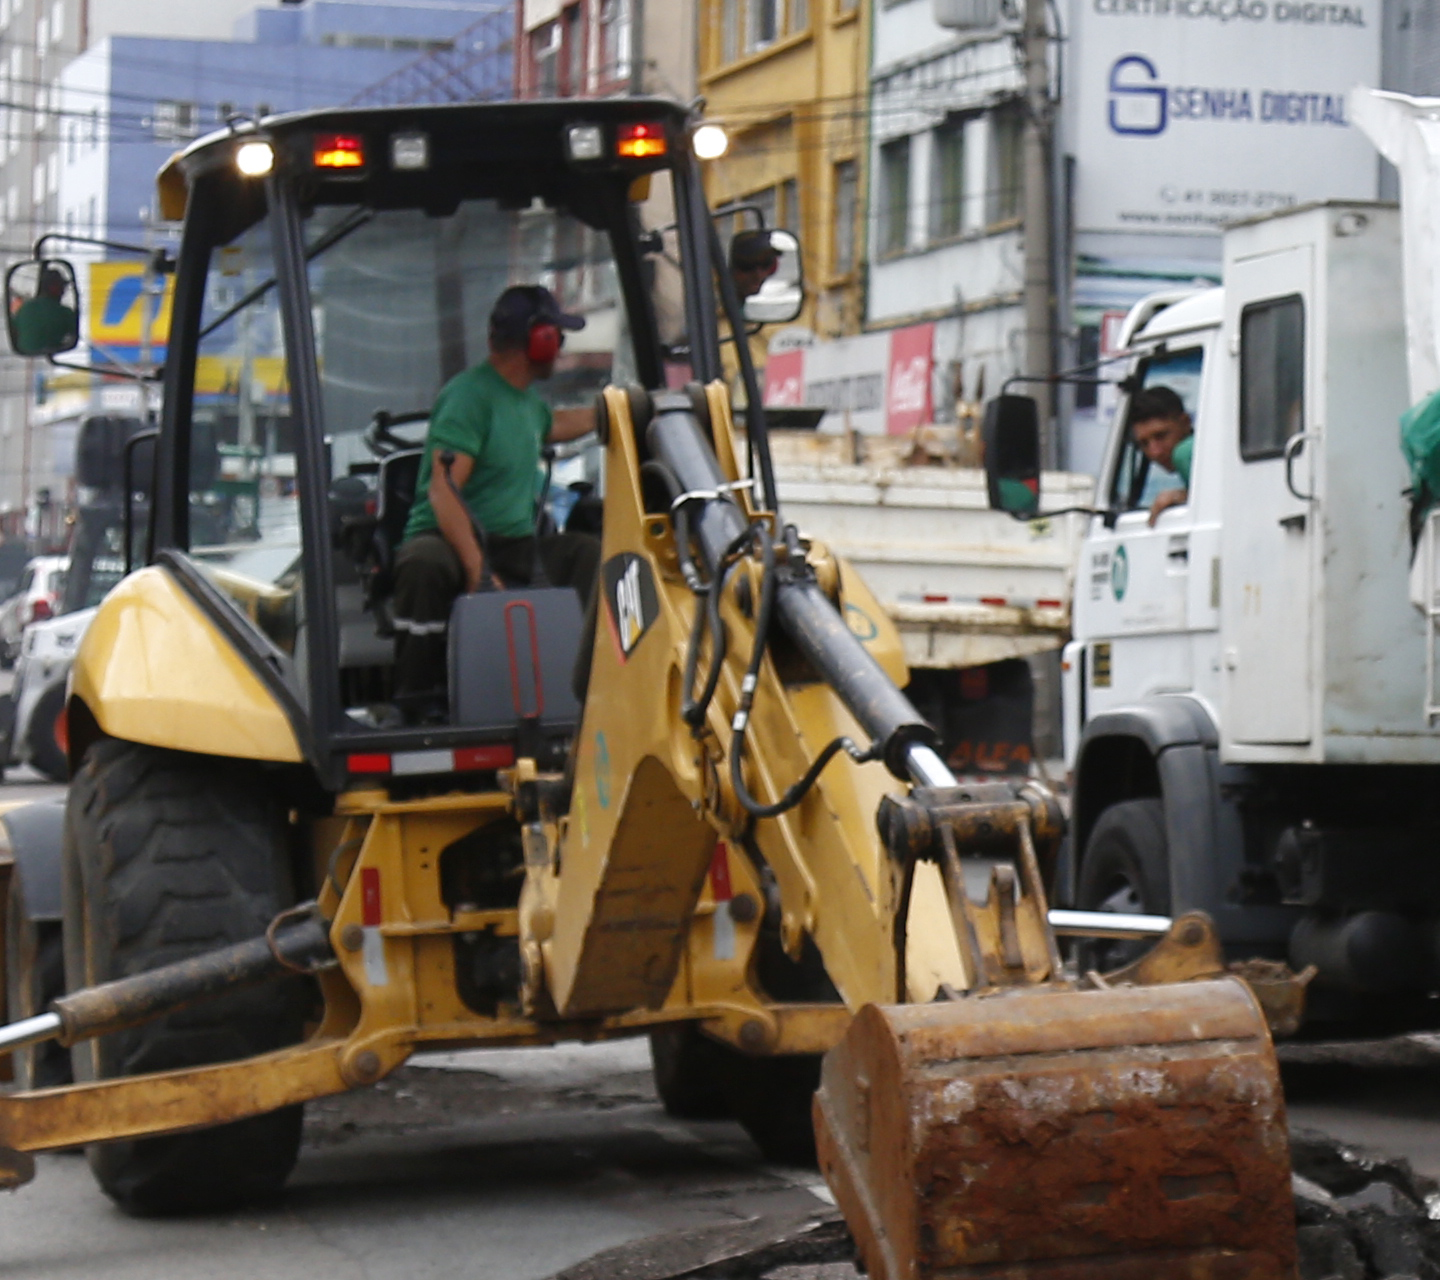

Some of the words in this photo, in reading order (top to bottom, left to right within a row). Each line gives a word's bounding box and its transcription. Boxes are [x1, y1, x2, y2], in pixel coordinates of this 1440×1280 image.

[1273, 2, 1366, 28] DIGITAL
[1169, 87, 1253, 120] SENHA
[1260, 90, 1350, 127] DIGITAL
